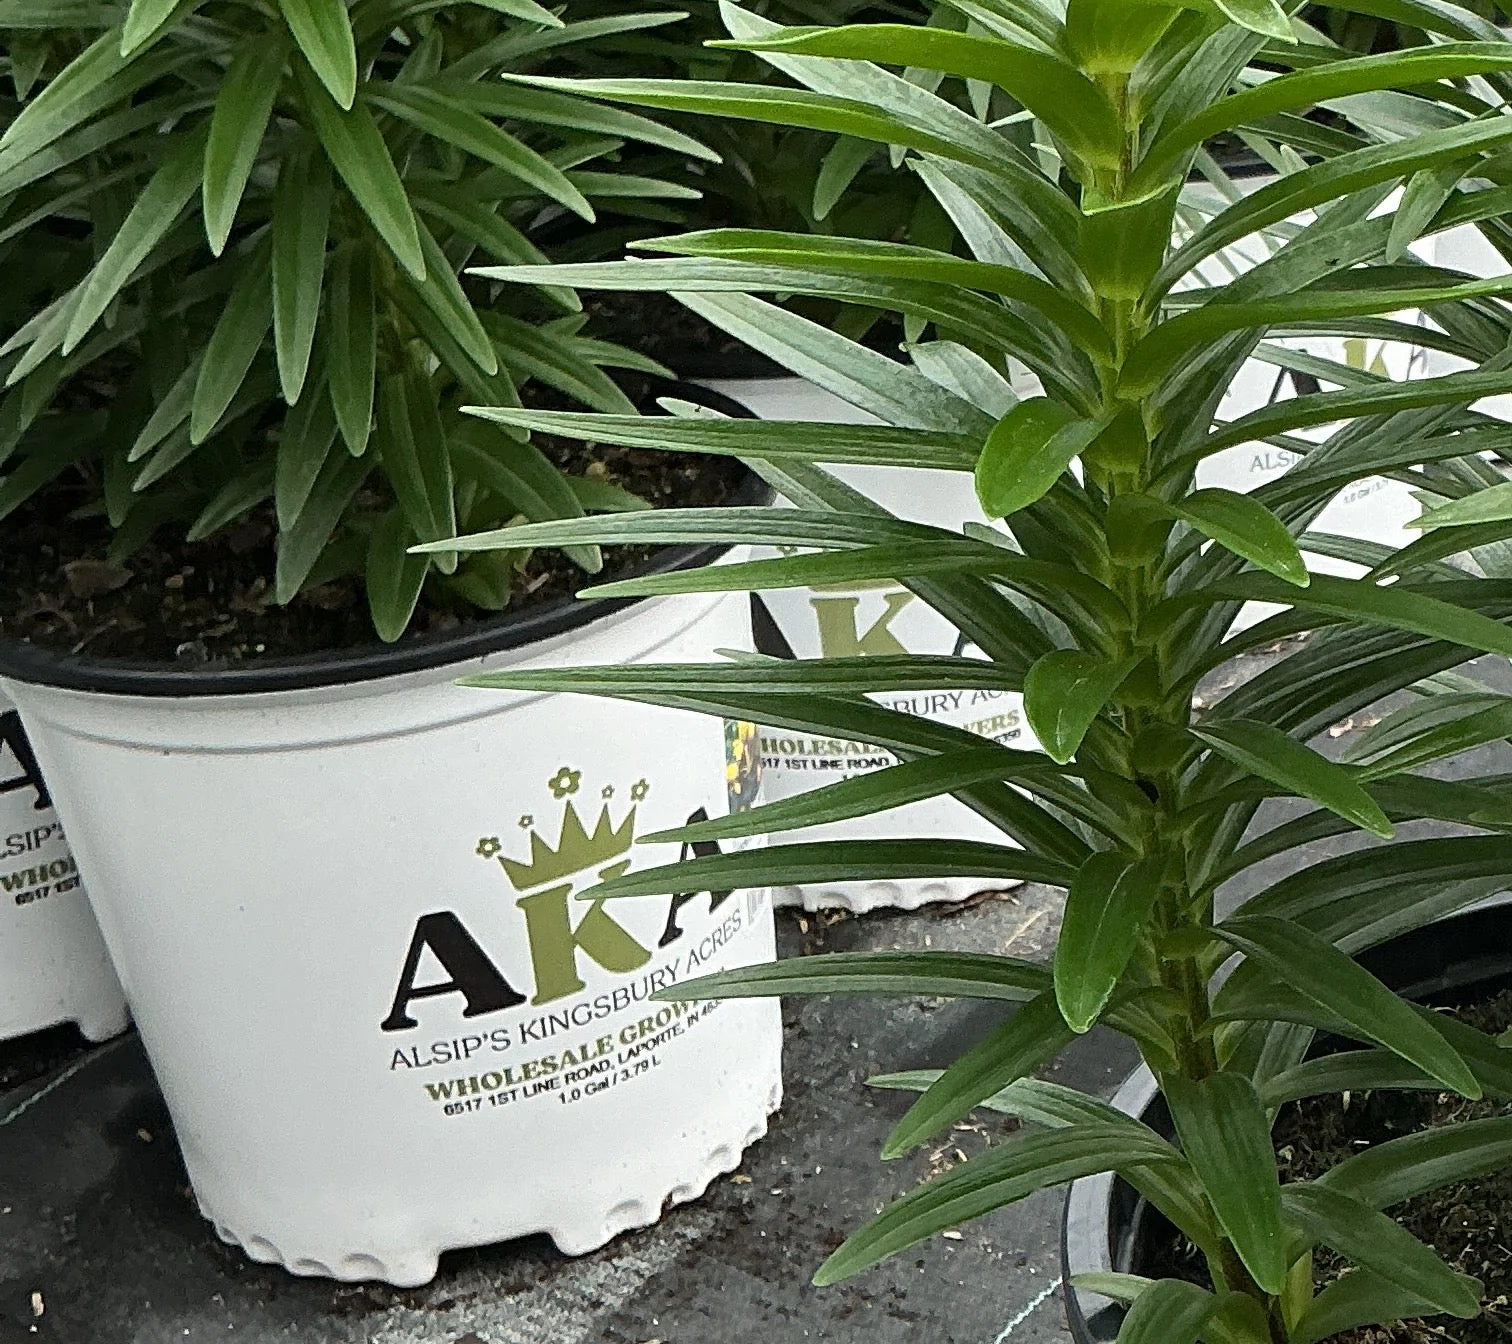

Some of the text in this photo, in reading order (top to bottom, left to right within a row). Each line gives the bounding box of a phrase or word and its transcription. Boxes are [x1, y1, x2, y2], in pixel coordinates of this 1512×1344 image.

[390, 908, 742, 1071] ALSIP'S KINGSBURY ACRES
[424, 1033, 615, 1101] WHOLESALE
[488, 1090, 518, 1108] 1ST
[523, 1077, 562, 1099] LINE
[558, 1087, 581, 1105] 1.0
[584, 1076, 610, 1097] Gal
[621, 1057, 650, 1083] 3.79
[651, 1053, 662, 1067] L
